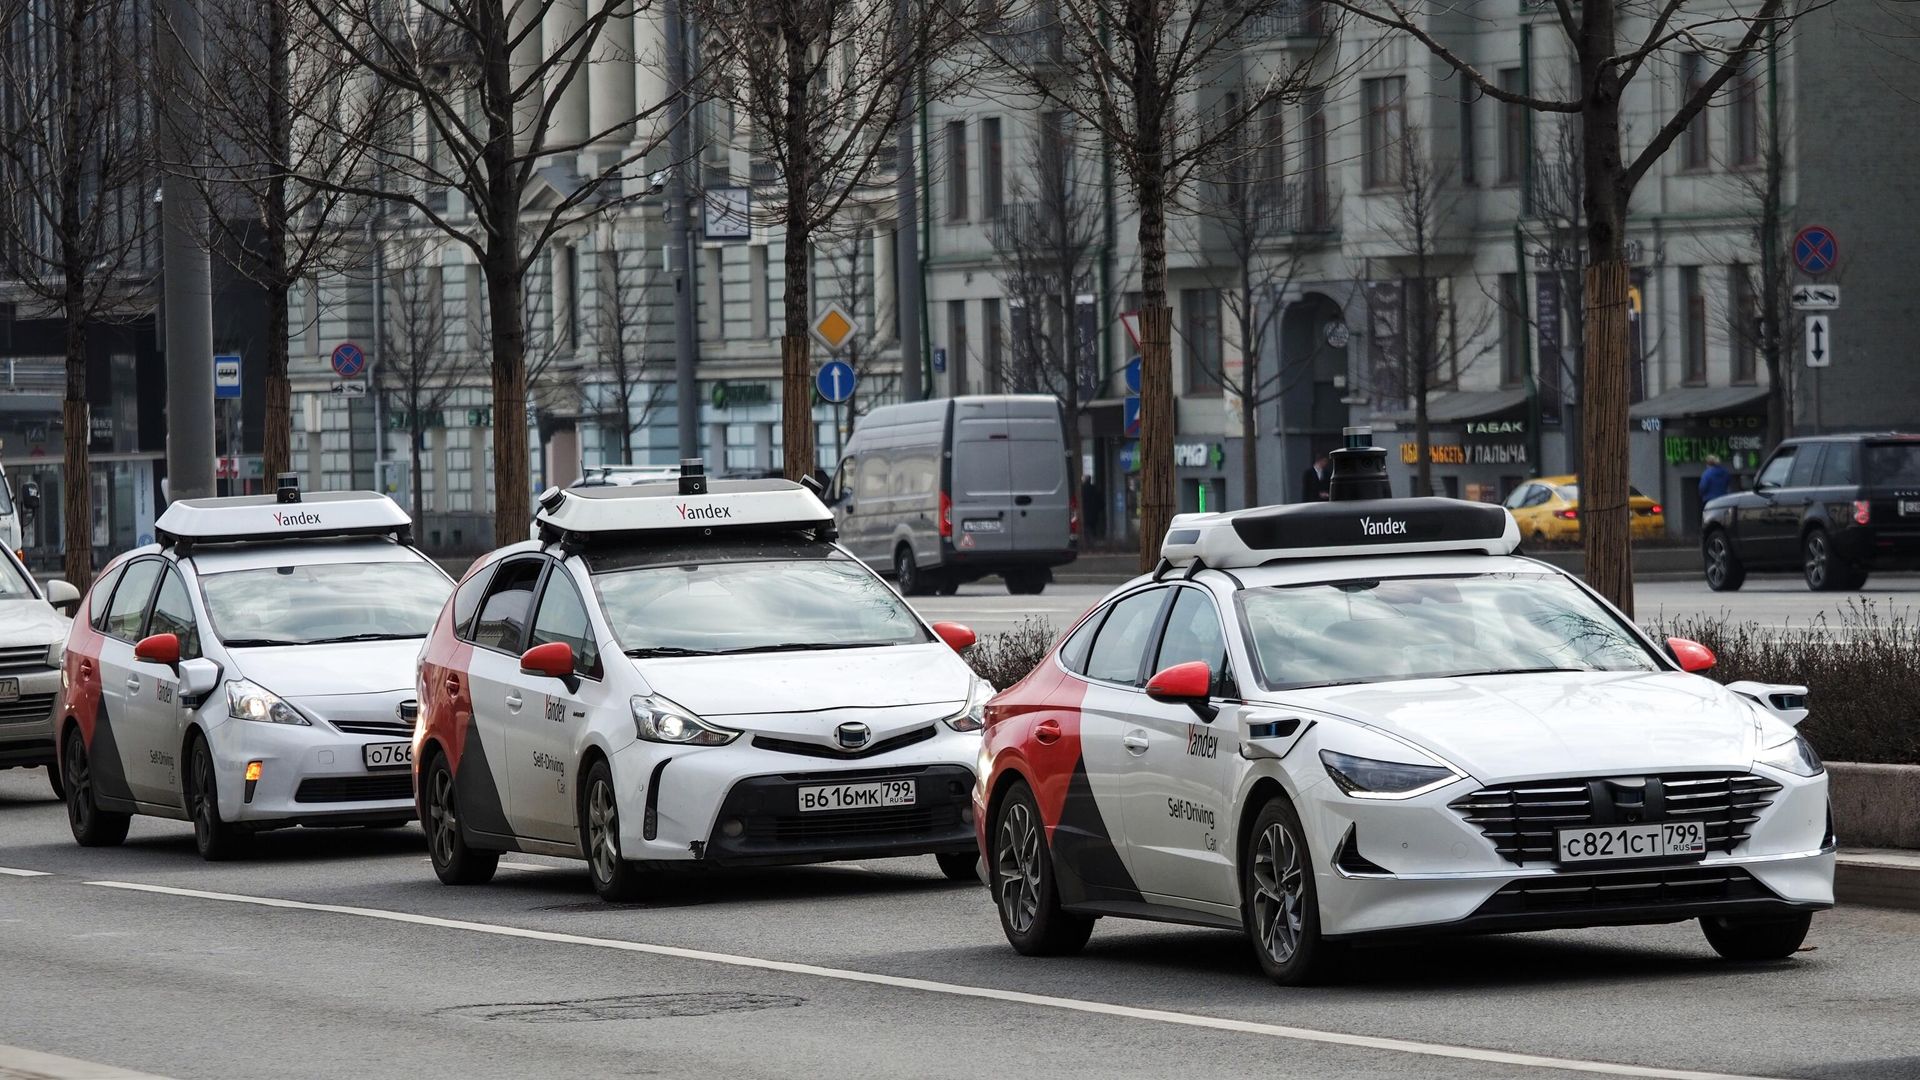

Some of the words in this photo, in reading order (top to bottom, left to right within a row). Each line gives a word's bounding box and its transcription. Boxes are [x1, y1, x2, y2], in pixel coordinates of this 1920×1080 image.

[1467, 422, 1523, 434] ТАБАК
[1728, 436, 1761, 450] СЕРВИС
[1400, 443, 1419, 464] ТАБА
[1475, 445, 1526, 463] ПАЛЫЧА
[273, 511, 322, 526] Yandex
[676, 503, 732, 520] Yandex
[1360, 516, 1407, 536] Yandex
[545, 693, 567, 723] Yandex
[1187, 723, 1218, 759] Yandex
[533, 751, 565, 777] Self-Driving
[557, 779, 566, 794] Car
[882, 782, 911, 798] 799
[1168, 797, 1215, 830] Self-Driving
[1204, 832, 1218, 852] Car
[1664, 824, 1699, 845] 799
[1673, 844, 1691, 852] RUS
